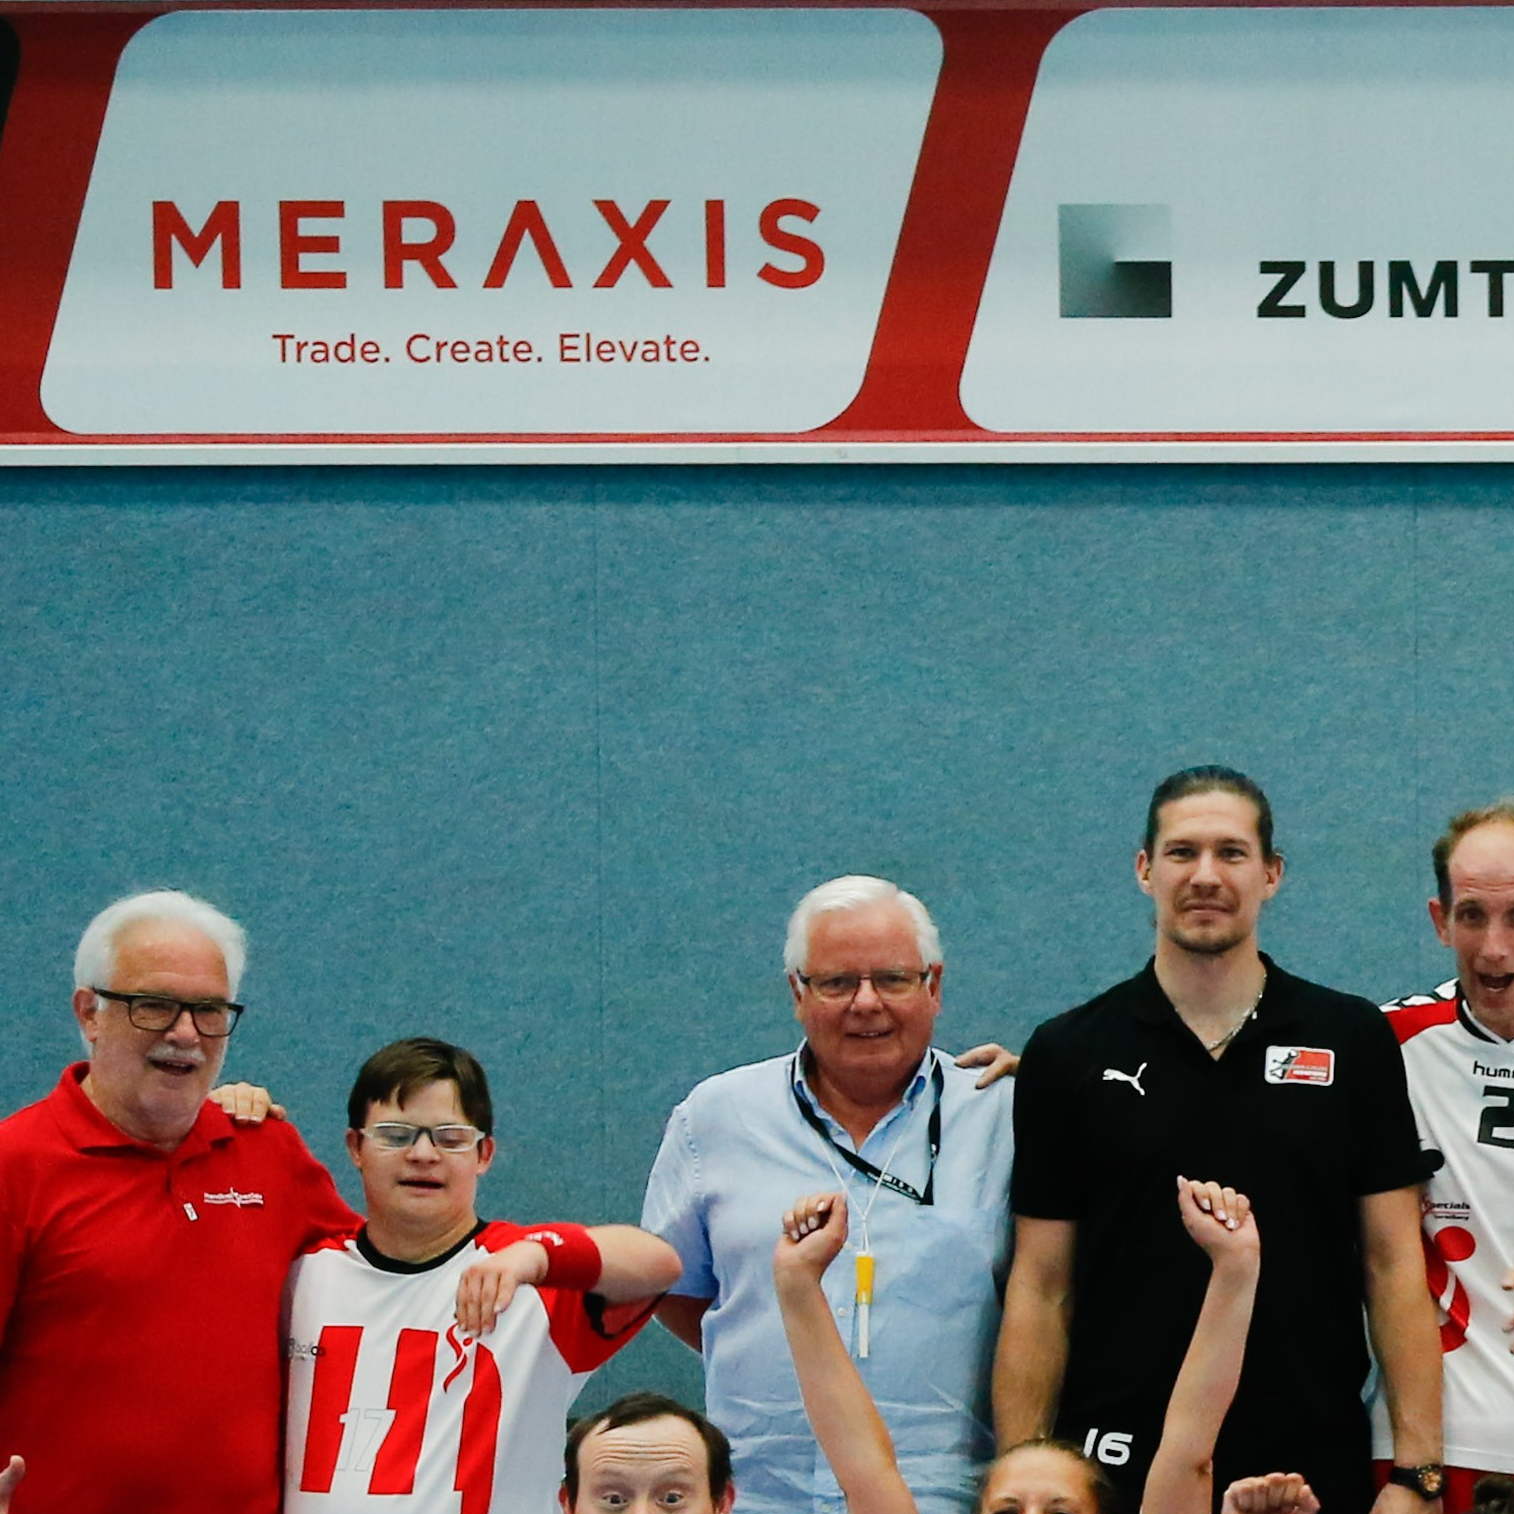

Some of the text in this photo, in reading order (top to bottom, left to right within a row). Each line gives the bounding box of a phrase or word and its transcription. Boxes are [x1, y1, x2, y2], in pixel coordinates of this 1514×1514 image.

[151, 197, 826, 290] MERAXIS
[271, 333, 711, 365] Trade. Create. Elevate.
[338, 1407, 398, 1473] 17
[1084, 1427, 1133, 1466] 16
